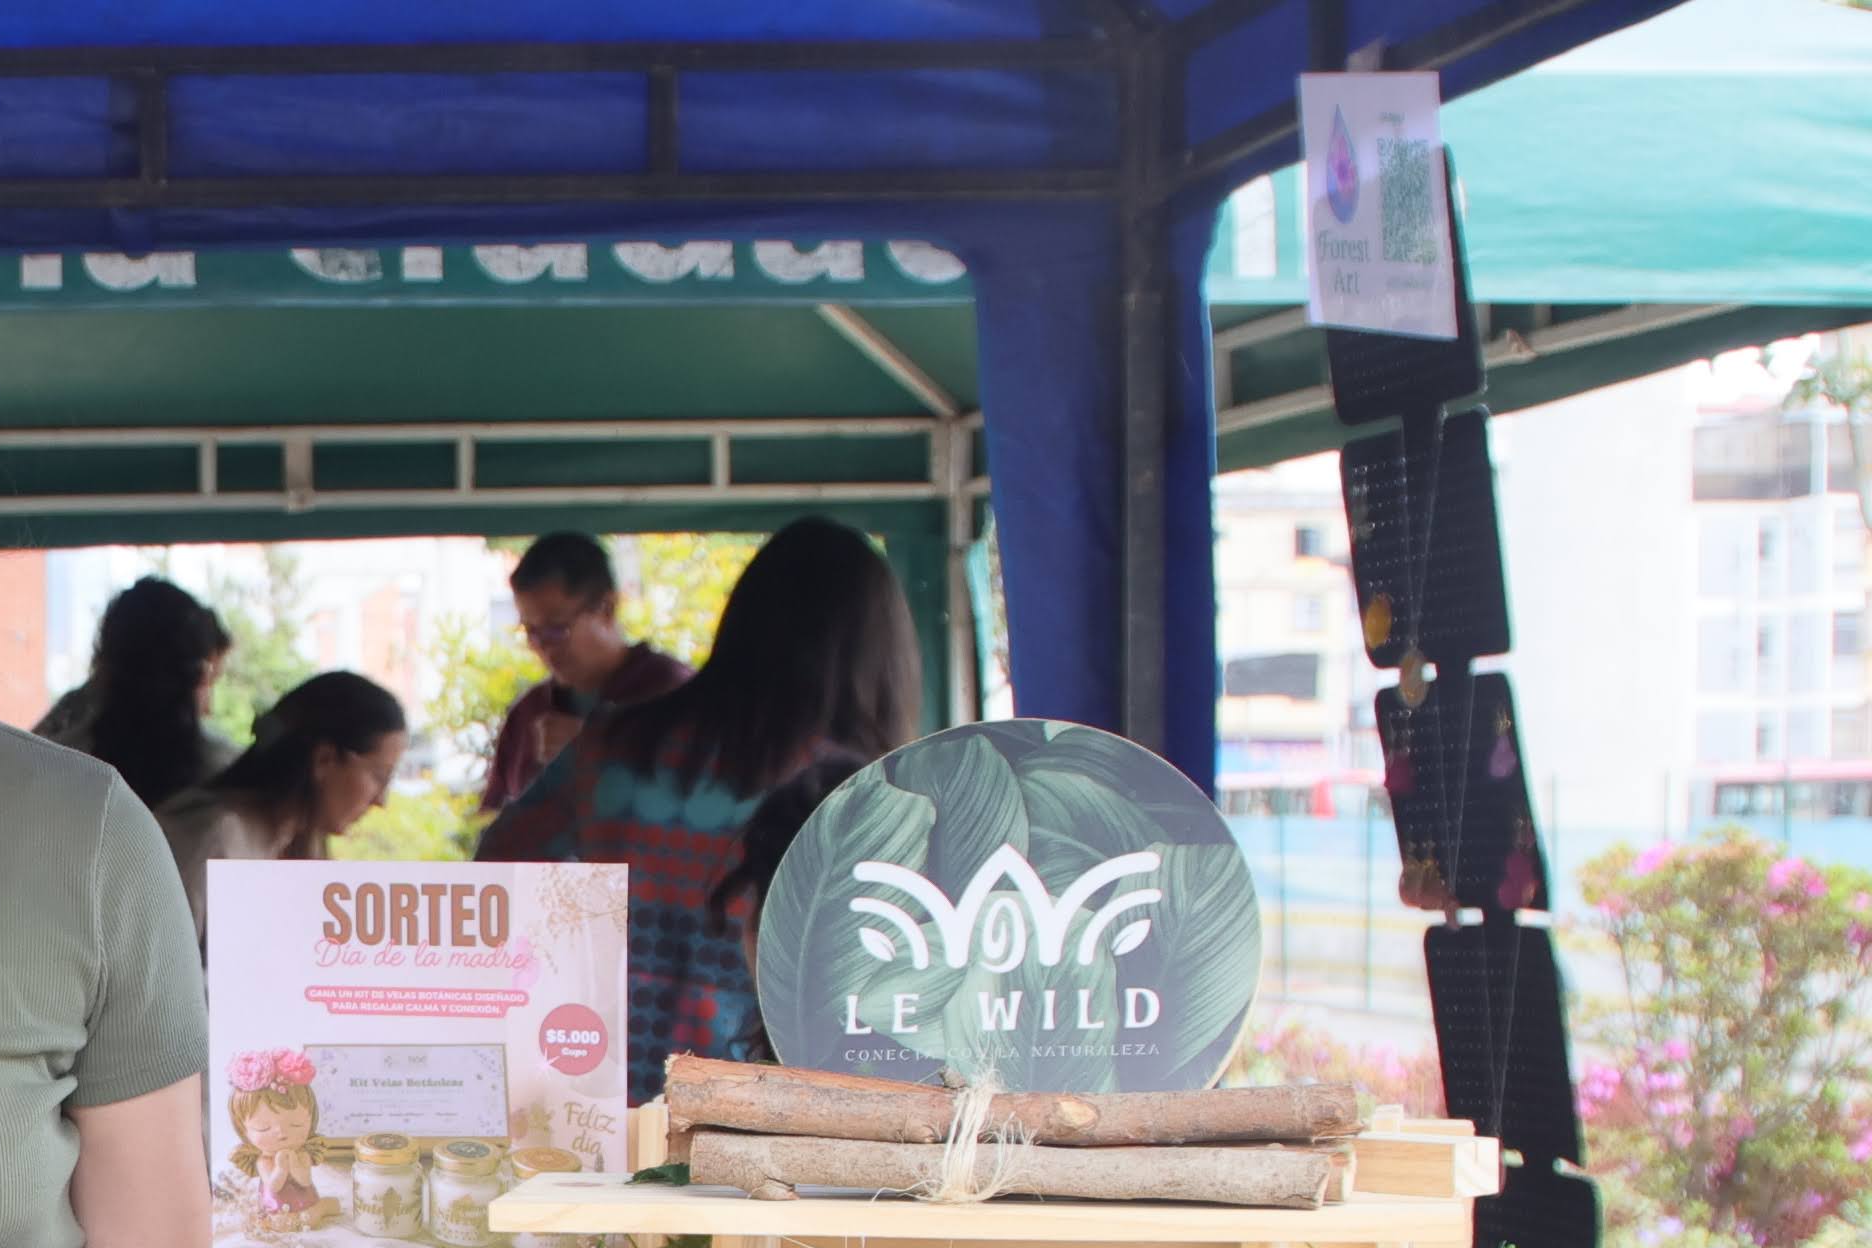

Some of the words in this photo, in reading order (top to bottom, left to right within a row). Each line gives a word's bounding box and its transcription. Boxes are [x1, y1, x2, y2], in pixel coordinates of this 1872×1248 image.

[1333, 268, 1360, 295] Art
[322, 882, 510, 948] SORTEO
[374, 938, 405, 967] de
[409, 938, 441, 969] la
[448, 942, 530, 969] madre
[309, 989, 336, 999] GANA
[339, 990, 352, 999] UN
[355, 990, 369, 999] KIT
[371, 991, 385, 1000] DE
[386, 991, 417, 1001] VELAS
[418, 989, 473, 1002] BOTÁNICAS
[474, 991, 525, 1003] DISEÑADO
[332, 1002, 359, 1011] PARA
[361, 1002, 403, 1012] REGALAR
[405, 1003, 439, 1013] CALMA
[441, 1004, 448, 1013] Y
[844, 993, 919, 1035] LE
[978, 988, 1161, 1032] WILD
[546, 1029, 600, 1045] $5.000
[561, 1047, 588, 1058] Cupo
[845, 1047, 937, 1062] CONECTA
[1032, 1043, 1161, 1058] NATURALEZA
[350, 1078, 368, 1088] Kit
[372, 1078, 403, 1088] Velas
[564, 1101, 617, 1135] Feliz
